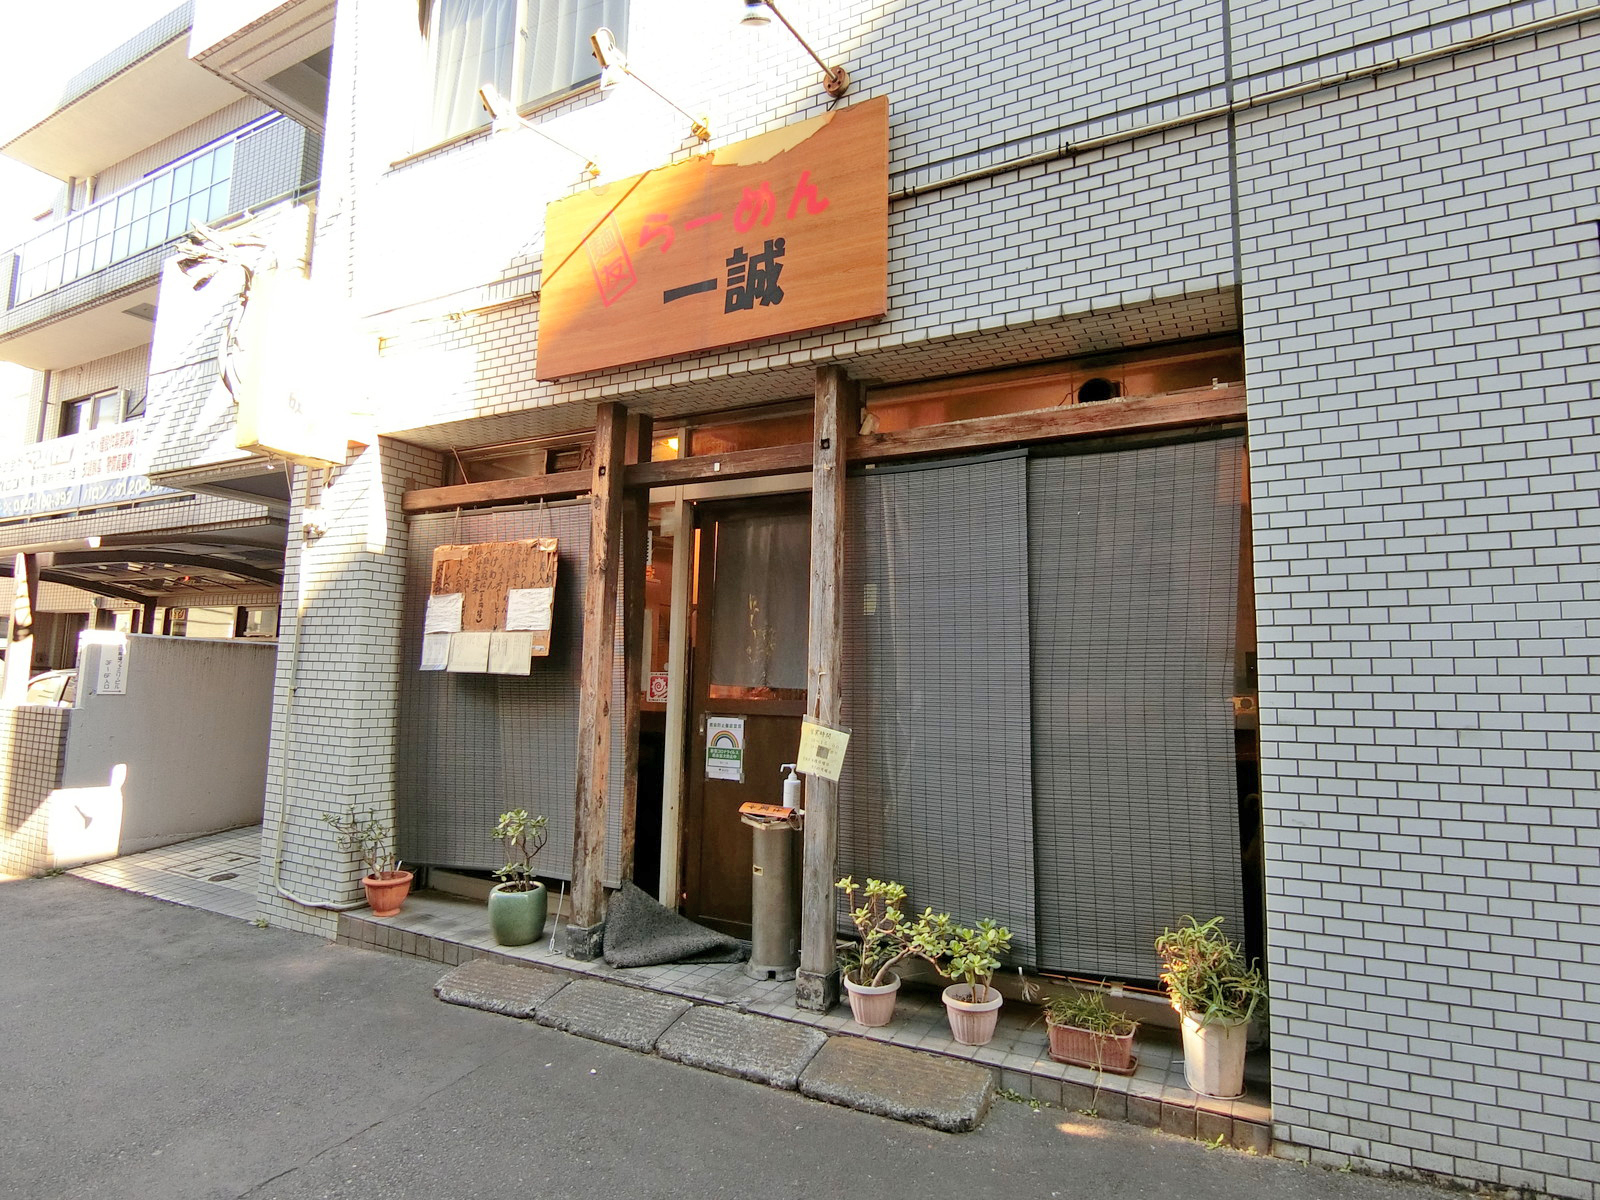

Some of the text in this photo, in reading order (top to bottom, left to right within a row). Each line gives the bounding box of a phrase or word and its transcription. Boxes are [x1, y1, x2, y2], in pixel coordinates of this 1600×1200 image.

[638, 170, 830, 254] らーめん
[663, 237, 786, 315] 一誠
